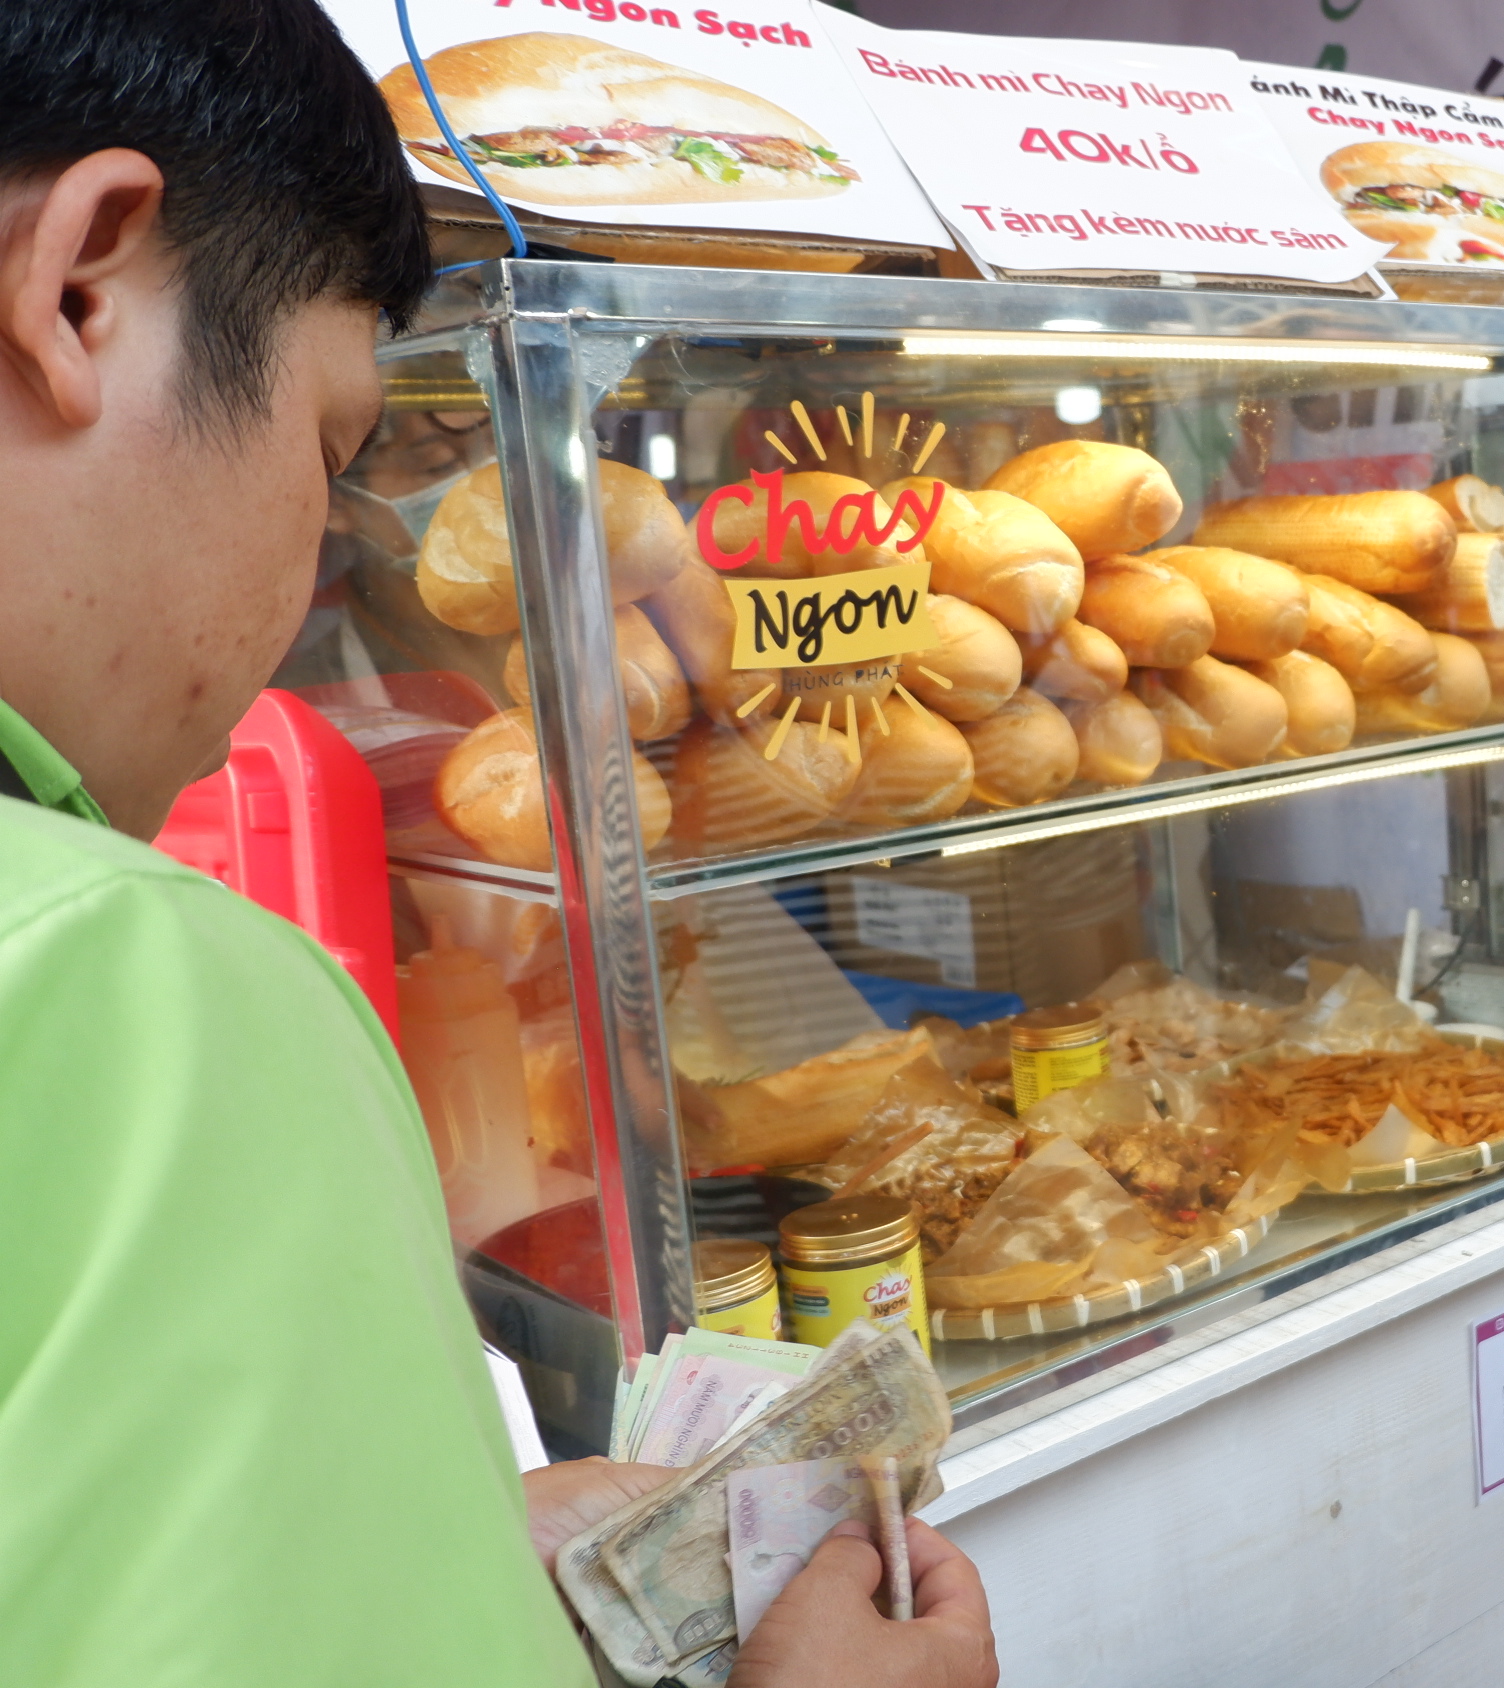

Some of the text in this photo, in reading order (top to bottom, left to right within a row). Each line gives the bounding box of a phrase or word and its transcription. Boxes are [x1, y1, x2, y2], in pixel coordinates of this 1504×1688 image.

[694, 9, 812, 48] Sạch
[857, 48, 978, 89] Bánh
[1032, 72, 1129, 109] Chay
[1130, 81, 1234, 115] Ngon
[1250, 75, 1312, 99] ánh
[1362, 91, 1438, 120] Thập
[1445, 101, 1504, 129] Cẩm
[1307, 106, 1386, 135] Chay
[1392, 119, 1473, 143] Ngon
[1019, 126, 1200, 175] 40k/ổ
[961, 204, 1348, 250] Tặng kèm nước sâm
[696, 467, 945, 570] Chay
[747, 584, 919, 663] Ngon
[789, 660, 904, 692] HÙNG PHÁT
[863, 1275, 912, 1302] Chay
[874, 1297, 908, 1316] Ngon
